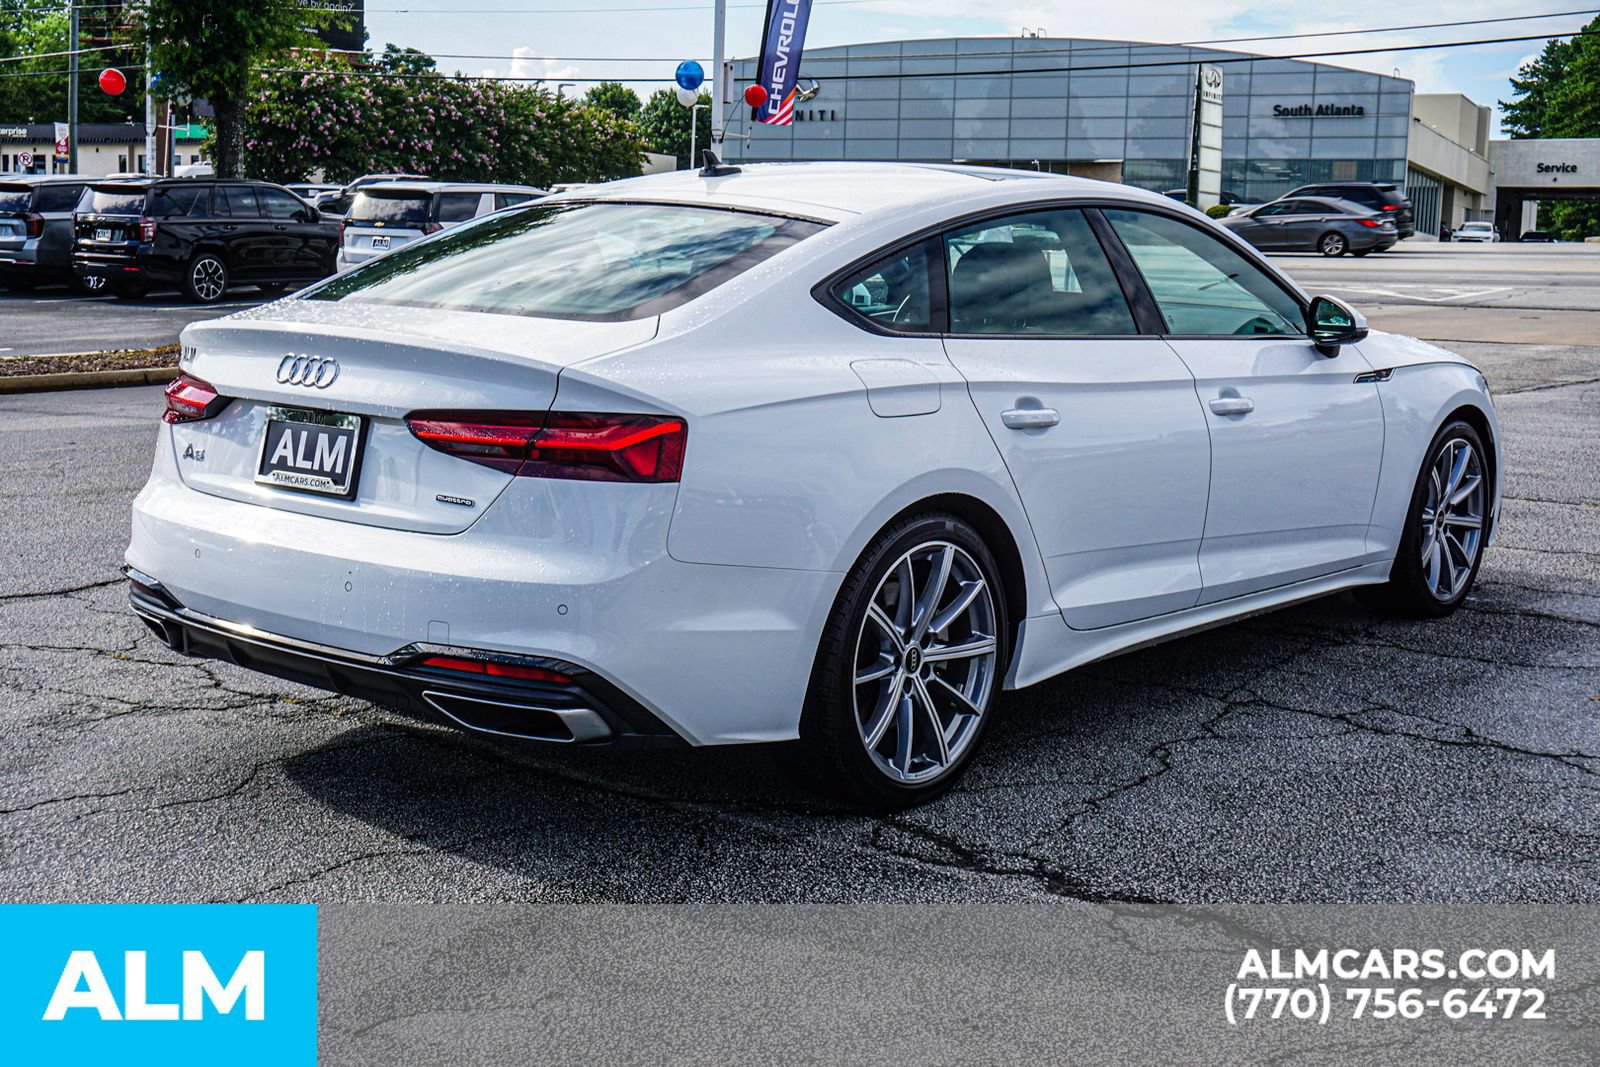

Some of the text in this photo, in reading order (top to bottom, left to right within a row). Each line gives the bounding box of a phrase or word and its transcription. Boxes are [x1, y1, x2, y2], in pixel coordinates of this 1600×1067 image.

[1273, 103, 1364, 117] South Atlanta
[1536, 162, 1577, 173] Service
[270, 428, 347, 474] ALM
[275, 473, 327, 487] ALMCARS.COM
[437, 495, 472, 506] quattro
